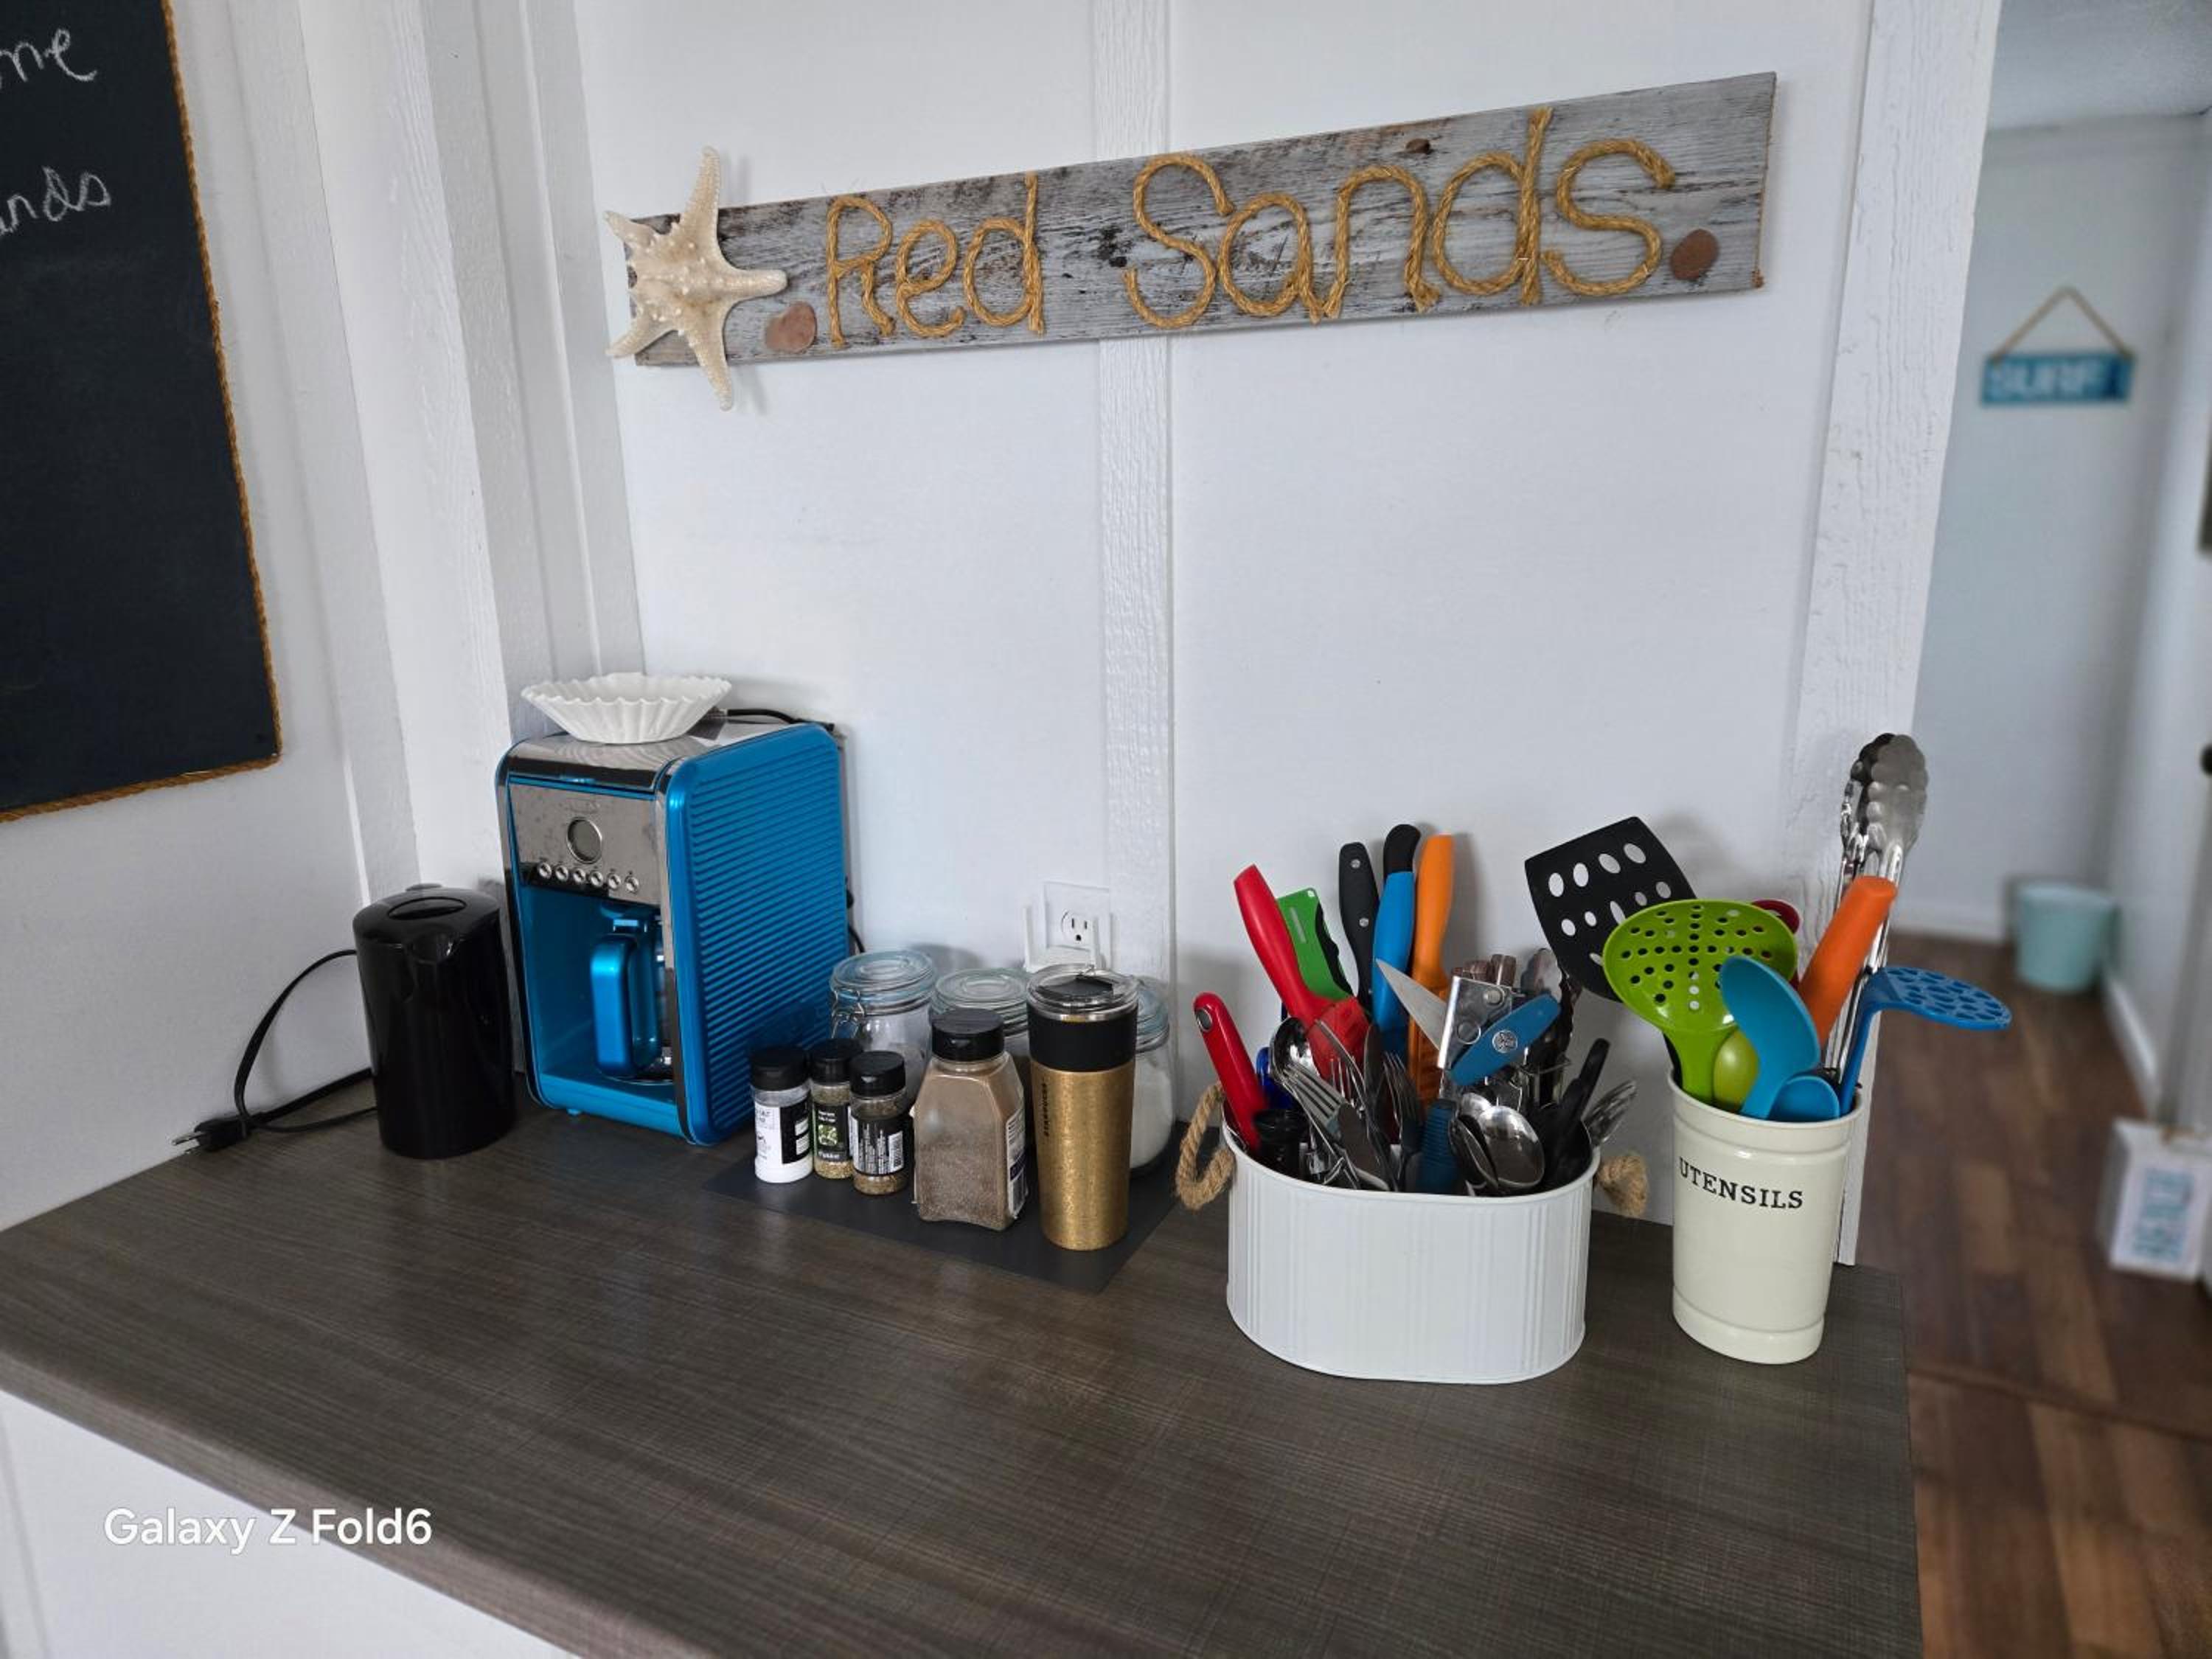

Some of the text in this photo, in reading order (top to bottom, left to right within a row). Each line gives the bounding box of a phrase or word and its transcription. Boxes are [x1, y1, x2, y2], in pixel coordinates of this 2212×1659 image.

[826, 107, 1676, 347] Red Sands
[1679, 1156, 1804, 1209] UTENSILS
